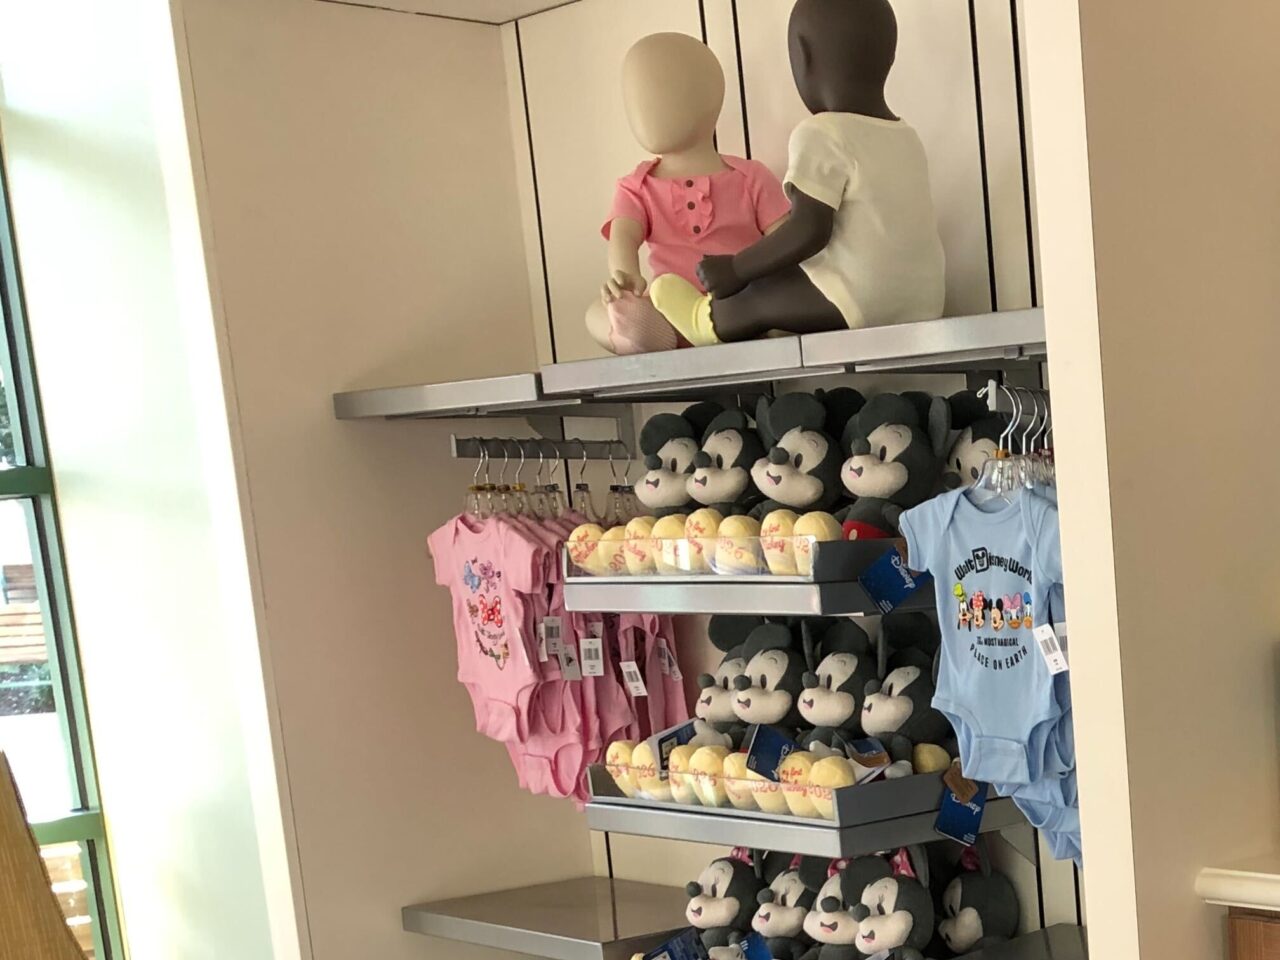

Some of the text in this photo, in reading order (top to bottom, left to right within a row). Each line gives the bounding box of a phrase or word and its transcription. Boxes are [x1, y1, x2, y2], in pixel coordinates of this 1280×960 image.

[954, 558, 976, 580] Walt
[984, 638, 997, 647] MOST
[998, 637, 1020, 647] MAGICAL
[969, 643, 1028, 671] PLACE ON EARTH
